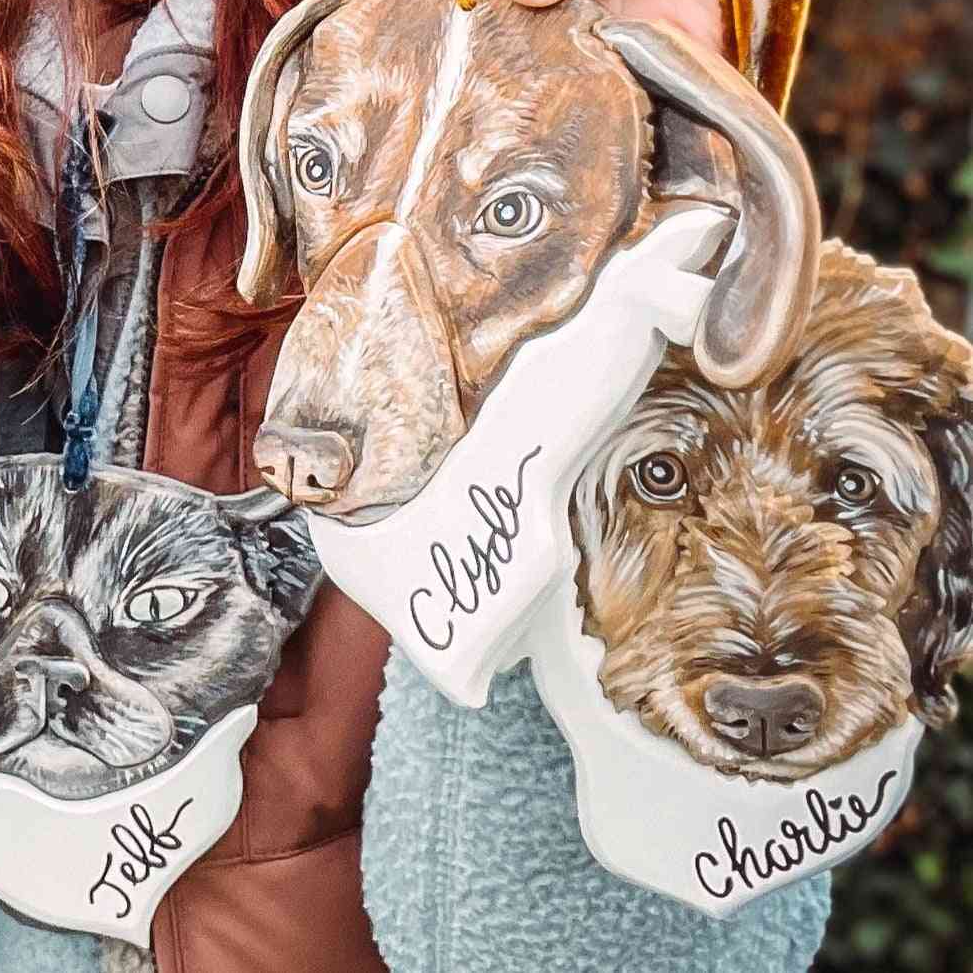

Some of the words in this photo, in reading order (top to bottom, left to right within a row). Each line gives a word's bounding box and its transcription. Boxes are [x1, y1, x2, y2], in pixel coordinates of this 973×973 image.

[410, 445, 542, 650] Clyde
[89, 797, 194, 918] Jeff
[694, 770, 897, 898] Charlie
